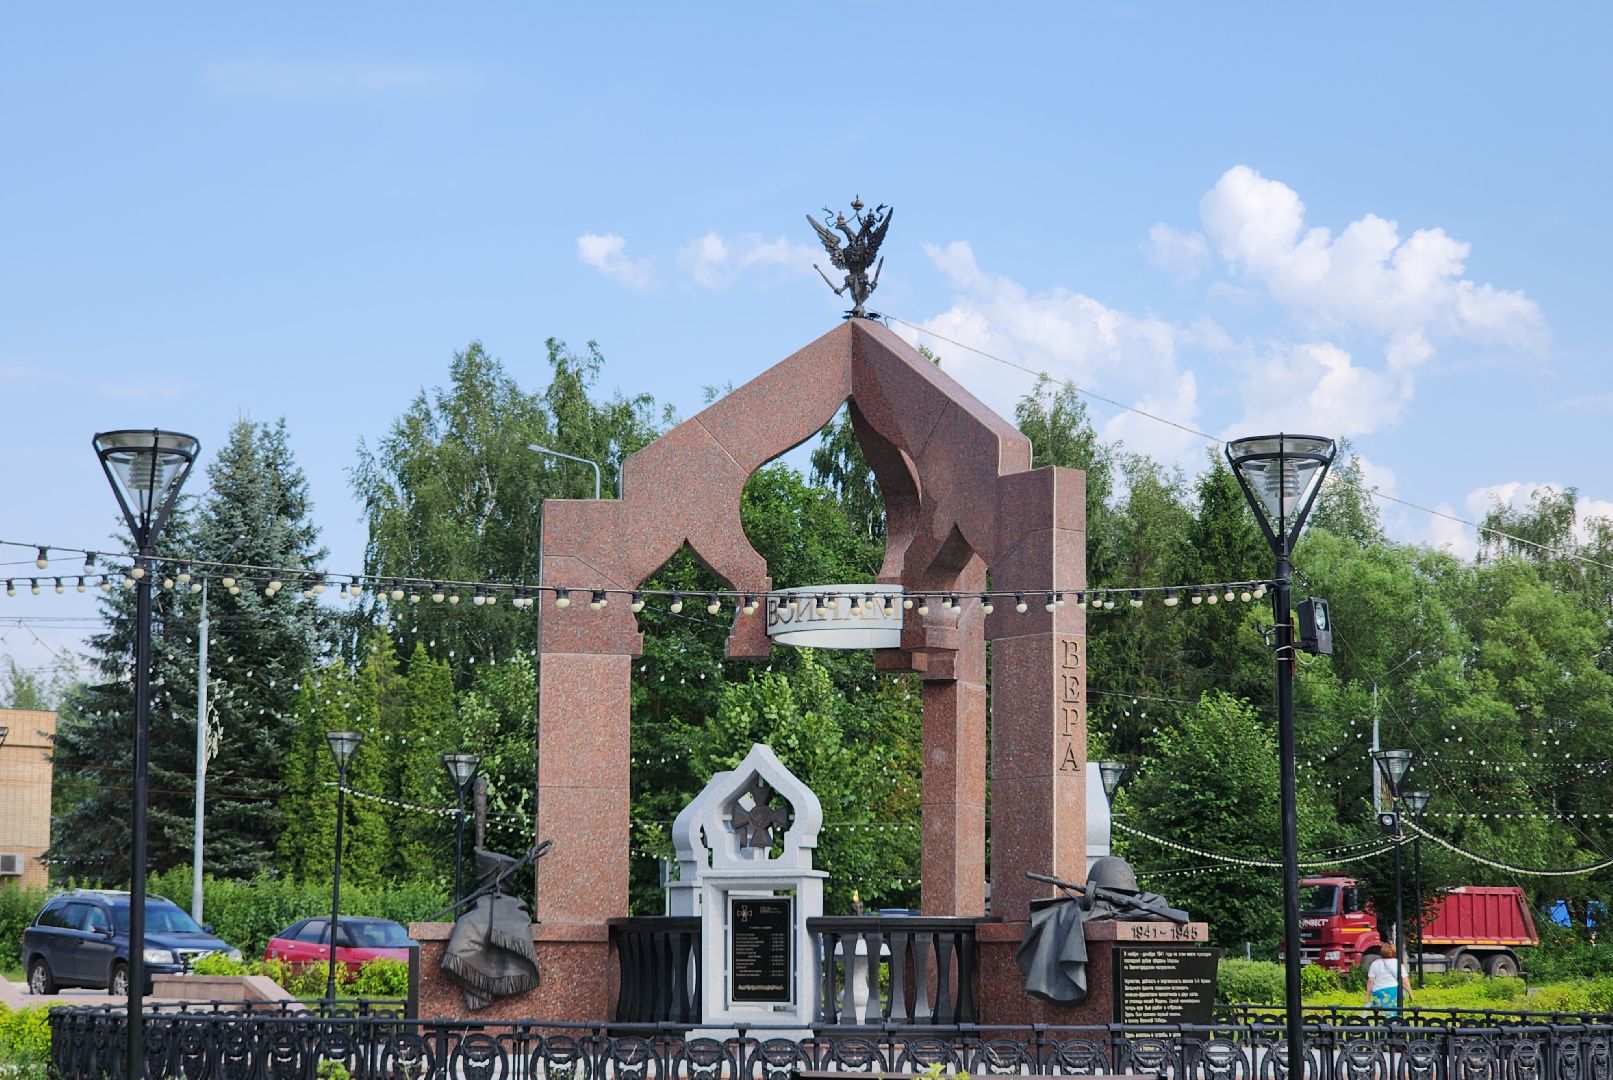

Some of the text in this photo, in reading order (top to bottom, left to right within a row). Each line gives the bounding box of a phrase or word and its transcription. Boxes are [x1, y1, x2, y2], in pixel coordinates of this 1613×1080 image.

[1059, 639, 1081, 771] ВЕРА
[1131, 925, 1157, 939] 1941
[1170, 926, 1198, 940] 1945
